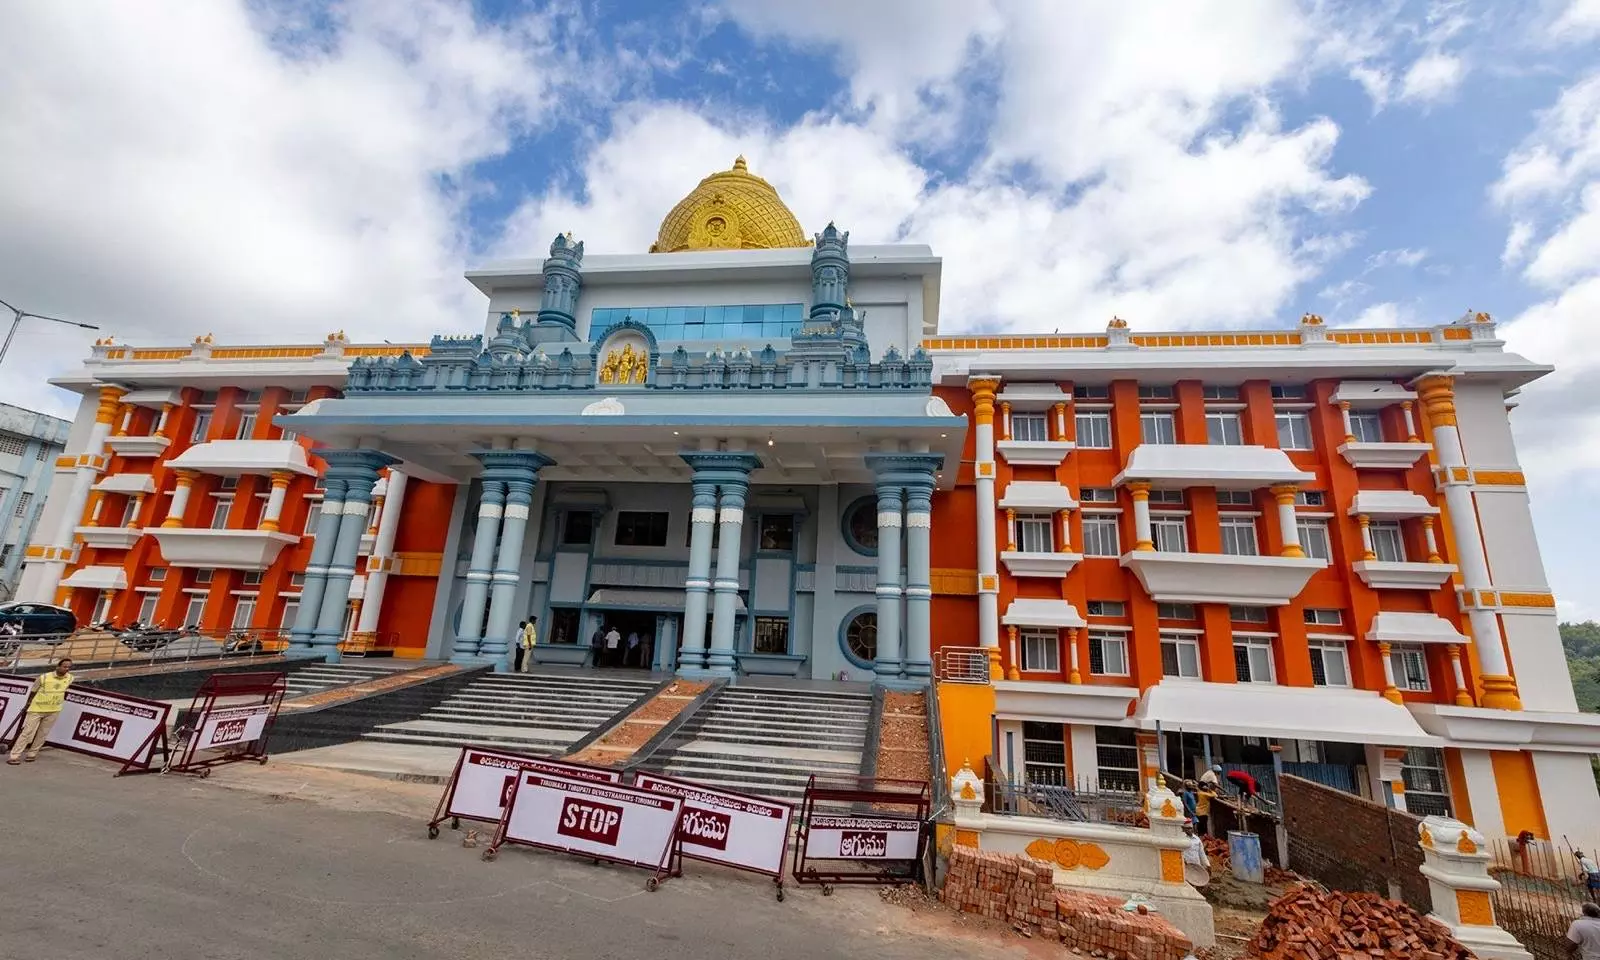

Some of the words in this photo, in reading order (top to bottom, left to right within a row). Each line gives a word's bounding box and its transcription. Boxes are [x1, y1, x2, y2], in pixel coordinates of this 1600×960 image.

[540, 779, 567, 790] TIRUMALA
[567, 783, 591, 793] TIRUPATI
[563, 802, 619, 835] STOP
